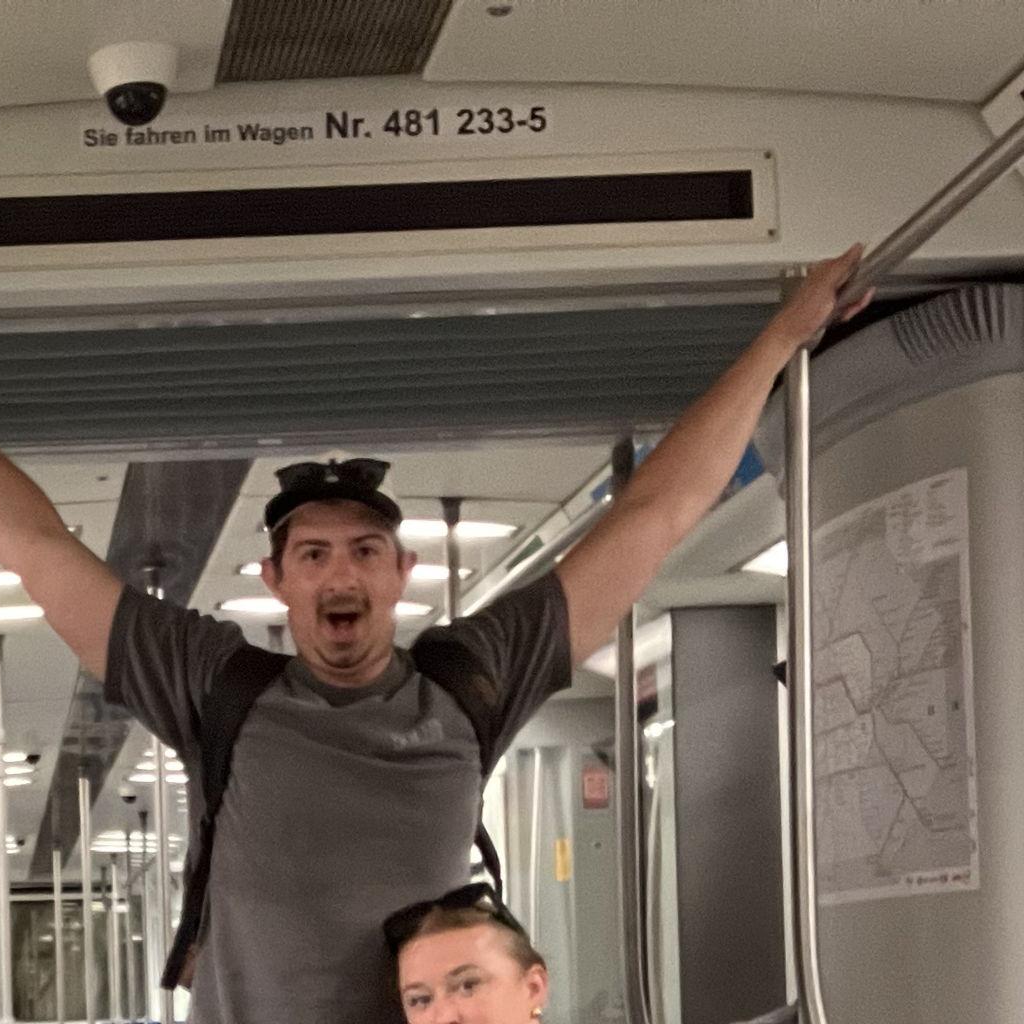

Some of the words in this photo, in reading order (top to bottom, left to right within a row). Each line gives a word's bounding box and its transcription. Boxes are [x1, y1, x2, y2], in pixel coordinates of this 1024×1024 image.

[84, 127, 118, 148] Sie
[126, 125, 197, 146] fahren
[204, 124, 231, 144] im
[237, 122, 314, 146] Wagen
[326, 110, 372, 139] Nr.
[383, 108, 440, 138] 481
[456, 106, 547, 136] 233-5
